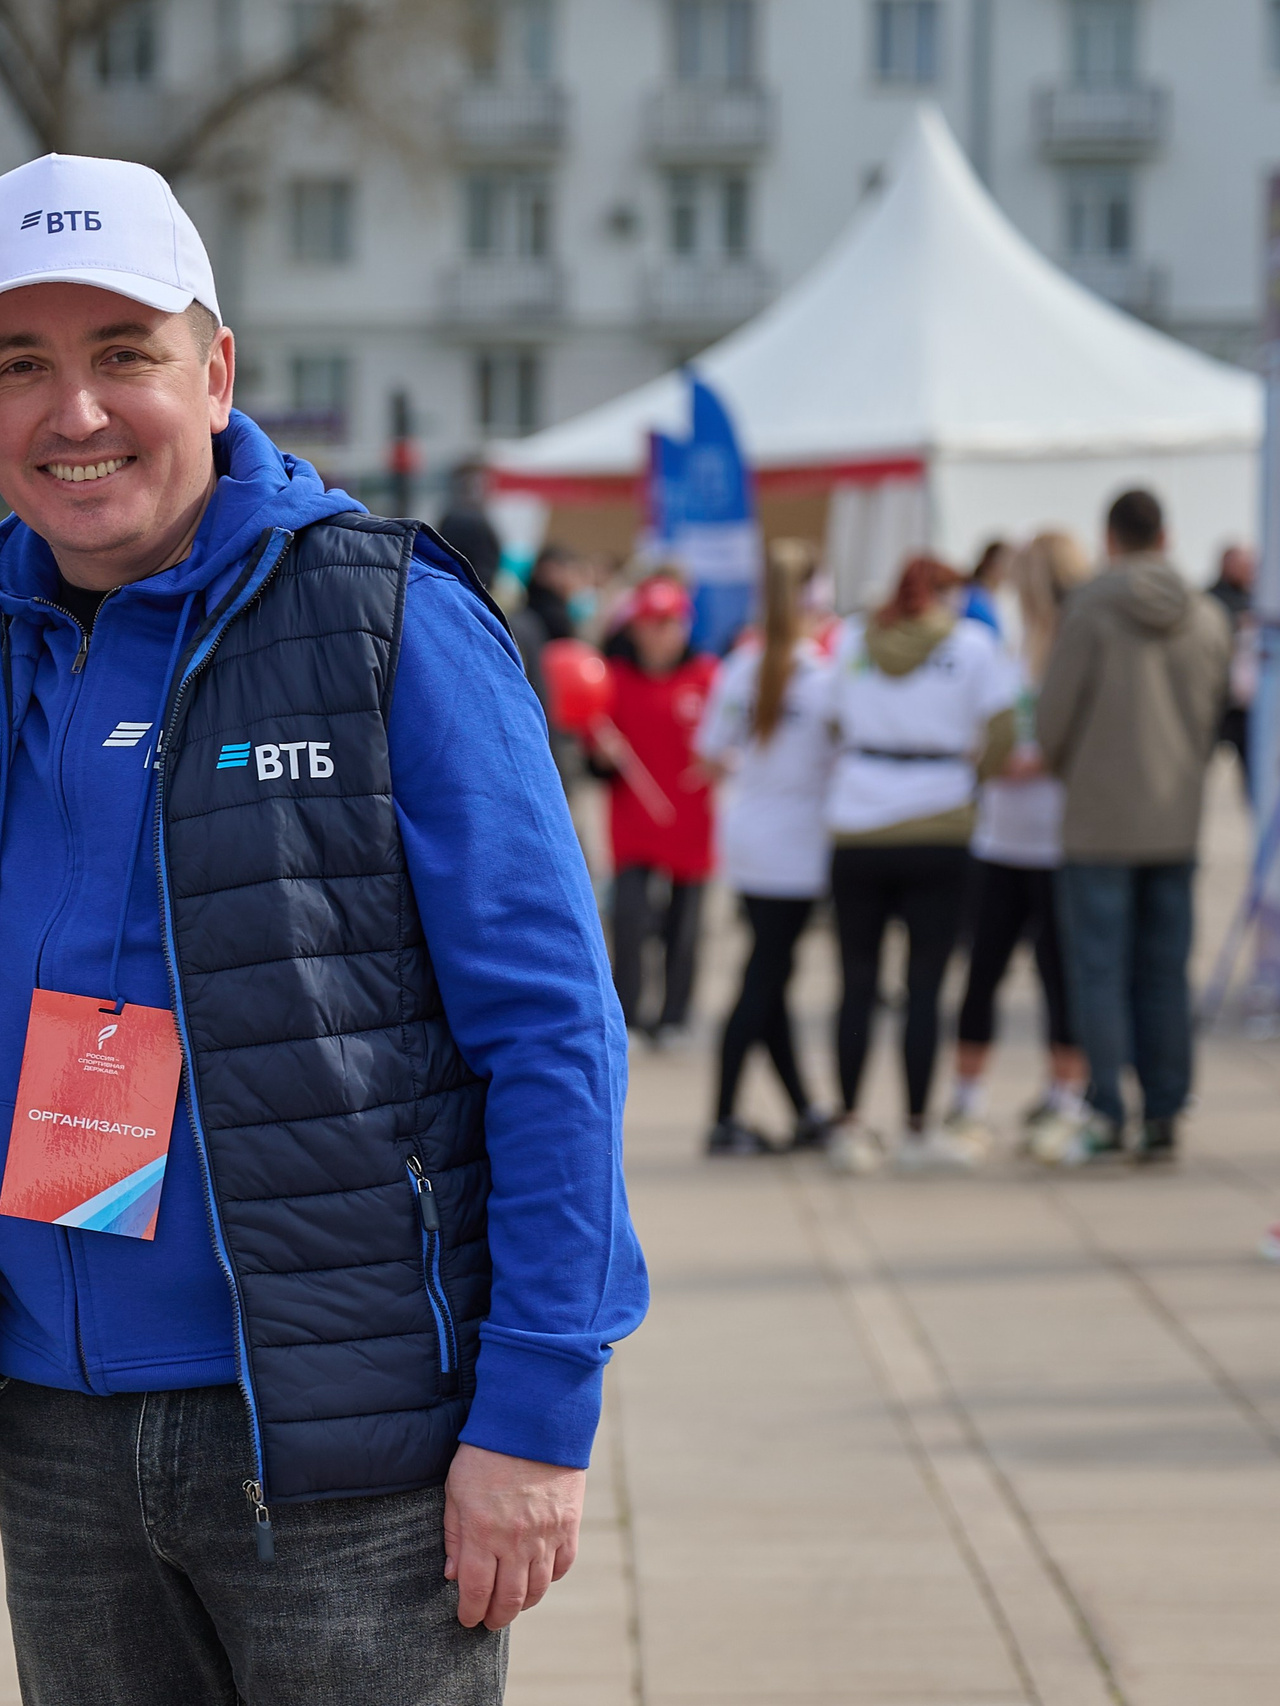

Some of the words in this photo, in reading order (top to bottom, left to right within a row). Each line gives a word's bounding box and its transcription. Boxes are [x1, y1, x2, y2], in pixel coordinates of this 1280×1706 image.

[46, 210, 102, 235] ВТБ
[254, 741, 335, 781] ВТБ
[77, 1057, 125, 1071] СПОРТИВНАЯ
[85, 1052, 115, 1062] РОССИЯ
[83, 1064, 119, 1076] ДЕРЖАВА
[27, 1108, 157, 1139] ОРГАНИЗАТОР
